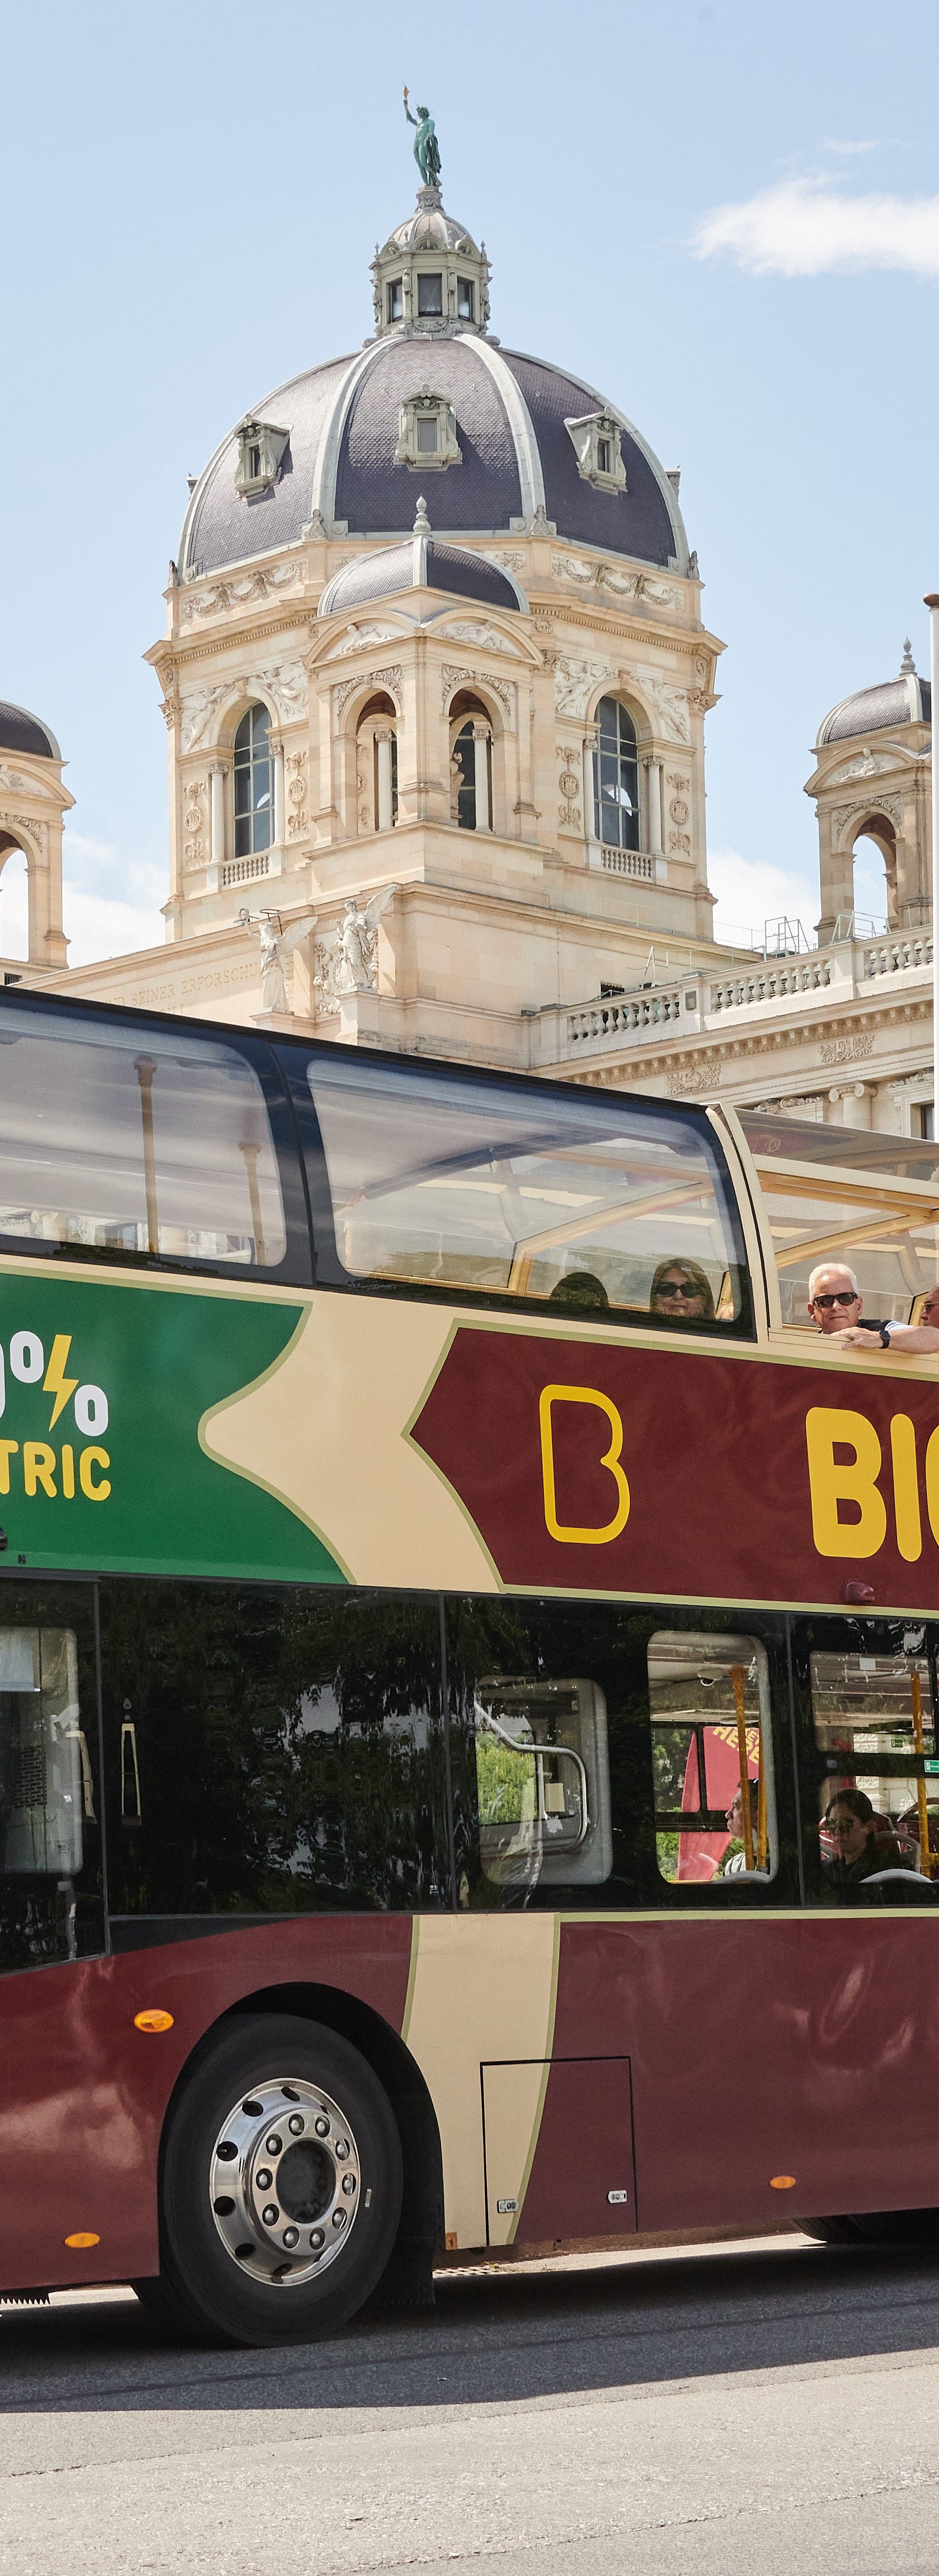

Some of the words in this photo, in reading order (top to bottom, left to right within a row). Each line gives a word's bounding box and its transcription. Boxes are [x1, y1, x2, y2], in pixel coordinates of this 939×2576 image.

[132, 984, 175, 1006] SEINER
[539, 1384, 630, 1544] B
[806, 1407, 939, 1562] BI
